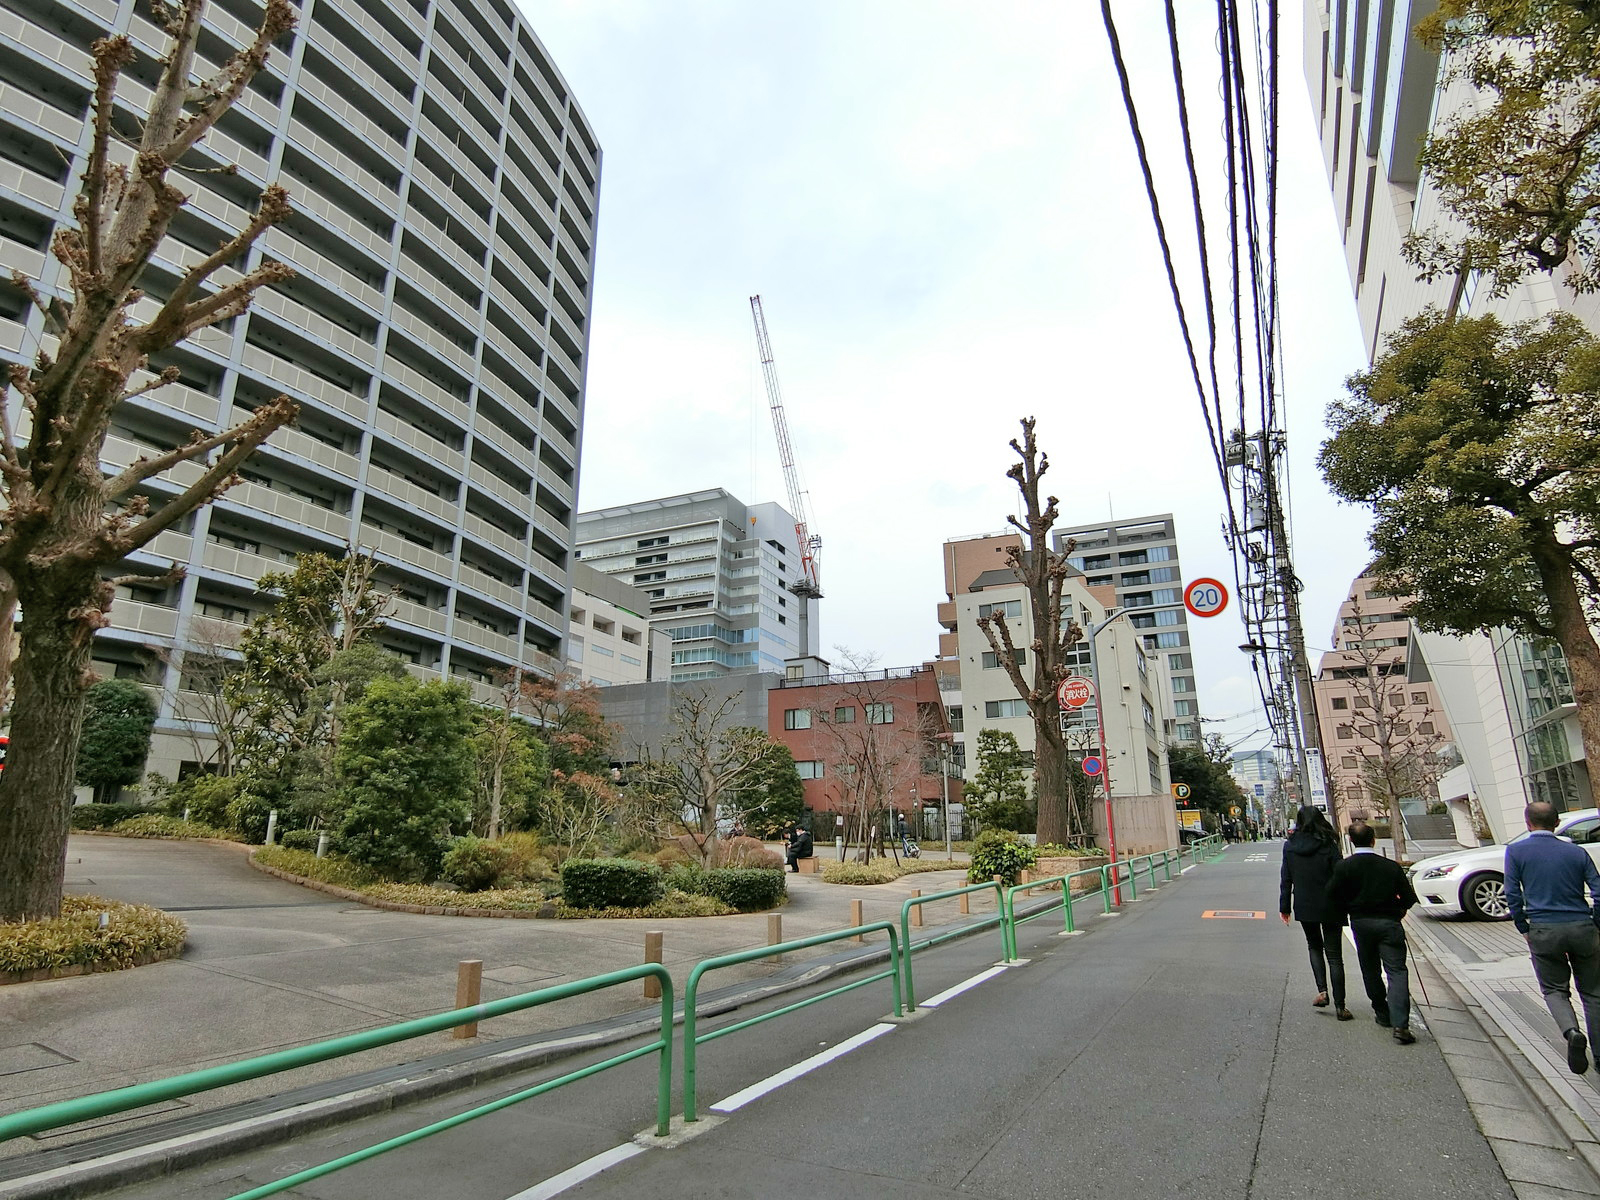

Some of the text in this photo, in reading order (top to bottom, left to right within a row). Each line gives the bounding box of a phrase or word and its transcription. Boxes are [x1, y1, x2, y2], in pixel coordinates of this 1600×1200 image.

[1193, 588, 1218, 607] 20
[1065, 687, 1088, 700] 消火栓
[1178, 785, 1187, 796] P
